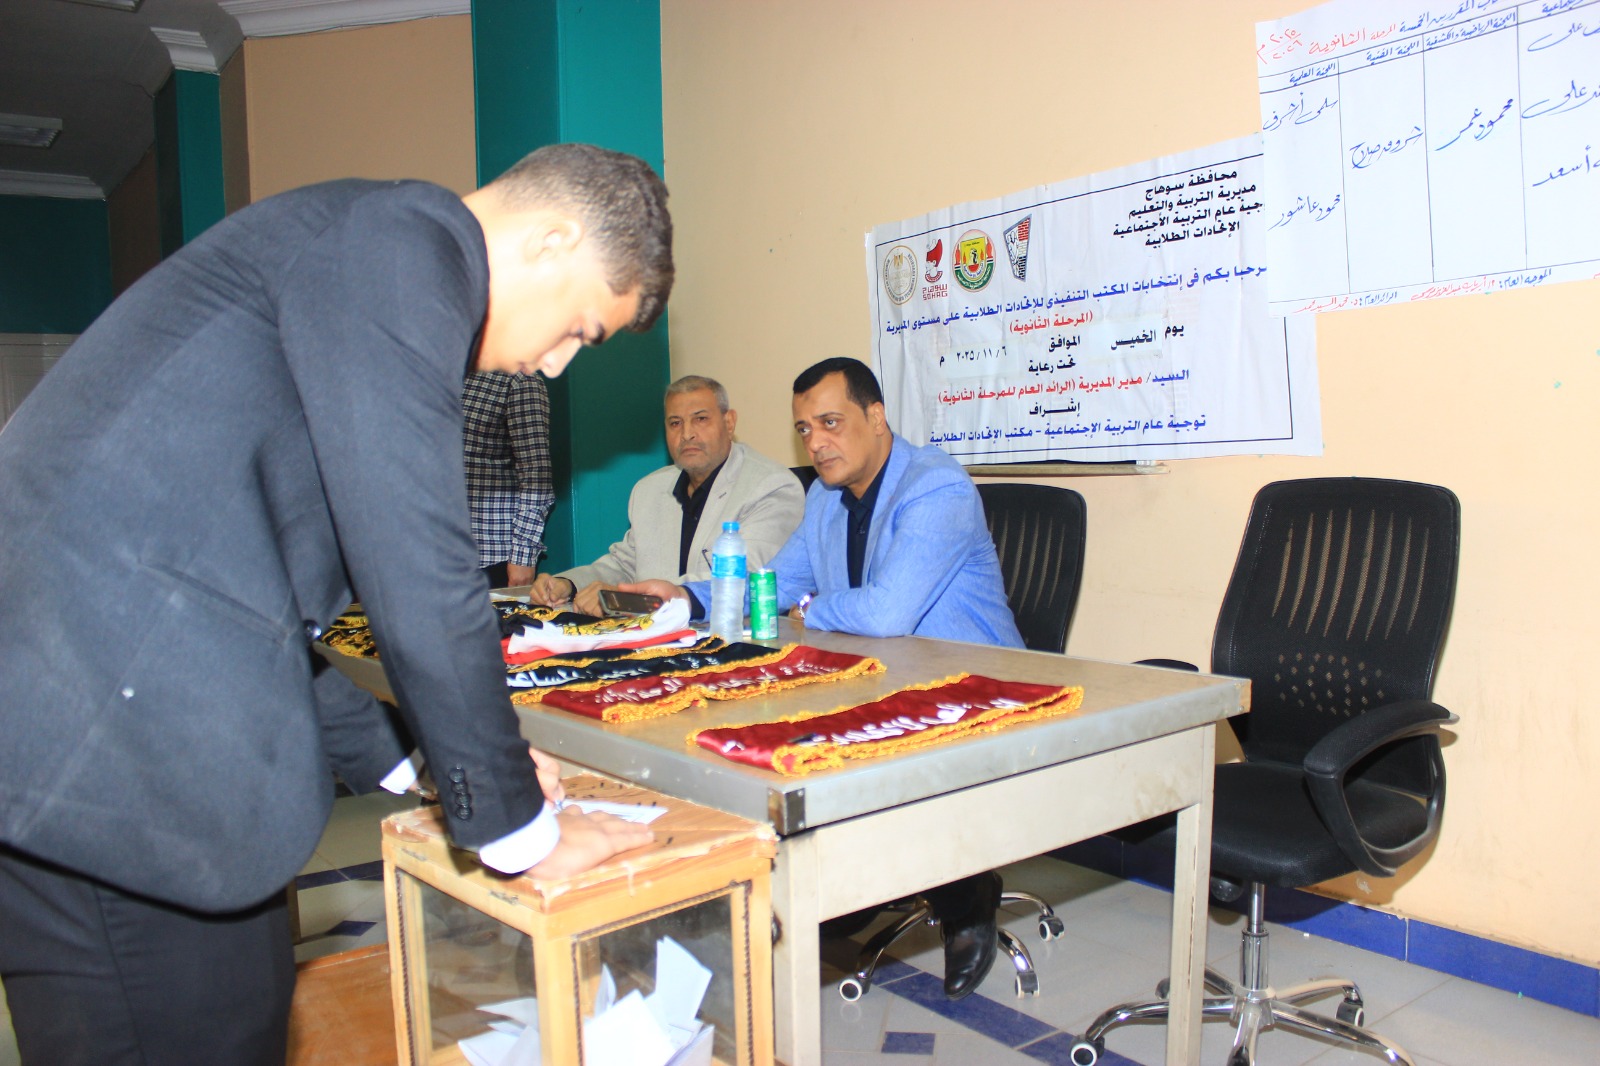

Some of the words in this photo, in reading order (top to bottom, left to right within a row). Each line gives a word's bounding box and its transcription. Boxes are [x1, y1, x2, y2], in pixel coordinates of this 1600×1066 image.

[1308, 27, 1366, 55] الثانوية
[1397, 40, 1419, 56] اللجنة
[1366, 47, 1393, 66] الفنية
[1316, 63, 1336, 78] اللجنة
[1474, 98, 1513, 141] محمود
[1434, 108, 1482, 151] عمر
[1532, 144, 1591, 187] أسعد
[1188, 169, 1238, 187] محافظة
[1145, 183, 1185, 201] سوهاج
[1176, 191, 1214, 209] التربية
[1217, 184, 1257, 200] مديرية
[1128, 199, 1174, 220] والتعليم
[1214, 205, 1236, 219] عام
[1239, 198, 1265, 215] جية
[1267, 196, 1319, 232] عاشور
[1315, 194, 1341, 222] محمود
[1172, 208, 1211, 226] التربية
[1193, 220, 1240, 239] الإتحادات
[1145, 230, 1190, 249] الطلابية
[1202, 267, 1230, 285] بكم
[1234, 265, 1267, 281] رحبا
[1092, 282, 1129, 302] المكتب
[1132, 274, 1183, 294] إنتخابات
[922, 291, 948, 301] SOHAG
[963, 304, 1003, 322] الطلابية
[1053, 309, 1093, 328] (المرحلة
[886, 320, 910, 335] المديرية
[1009, 317, 1050, 336] الثانوية)
[1164, 324, 1185, 341] يوم
[1048, 333, 1081, 353] الموافق
[1110, 328, 1157, 351] الخميس
[939, 356, 945, 368] م
[1028, 360, 1055, 374] رعاية
[1056, 354, 1076, 371] تحت
[1017, 383, 1044, 399] العام
[1045, 379, 1076, 394] (الرائد
[1079, 376, 1115, 392] المديرية
[1118, 375, 1143, 390] مدير
[938, 389, 975, 406] الثانوية)
[977, 385, 1017, 401] للمرحلة
[1028, 398, 1081, 417] إشراف
[1004, 426, 1033, 441] مكتب
[1044, 422, 1101, 440] الإجتماعية
[1105, 417, 1140, 436] التربية
[1142, 418, 1164, 434] عام
[929, 430, 966, 446] الطلابية
[968, 428, 1002, 445] الإتحادات
